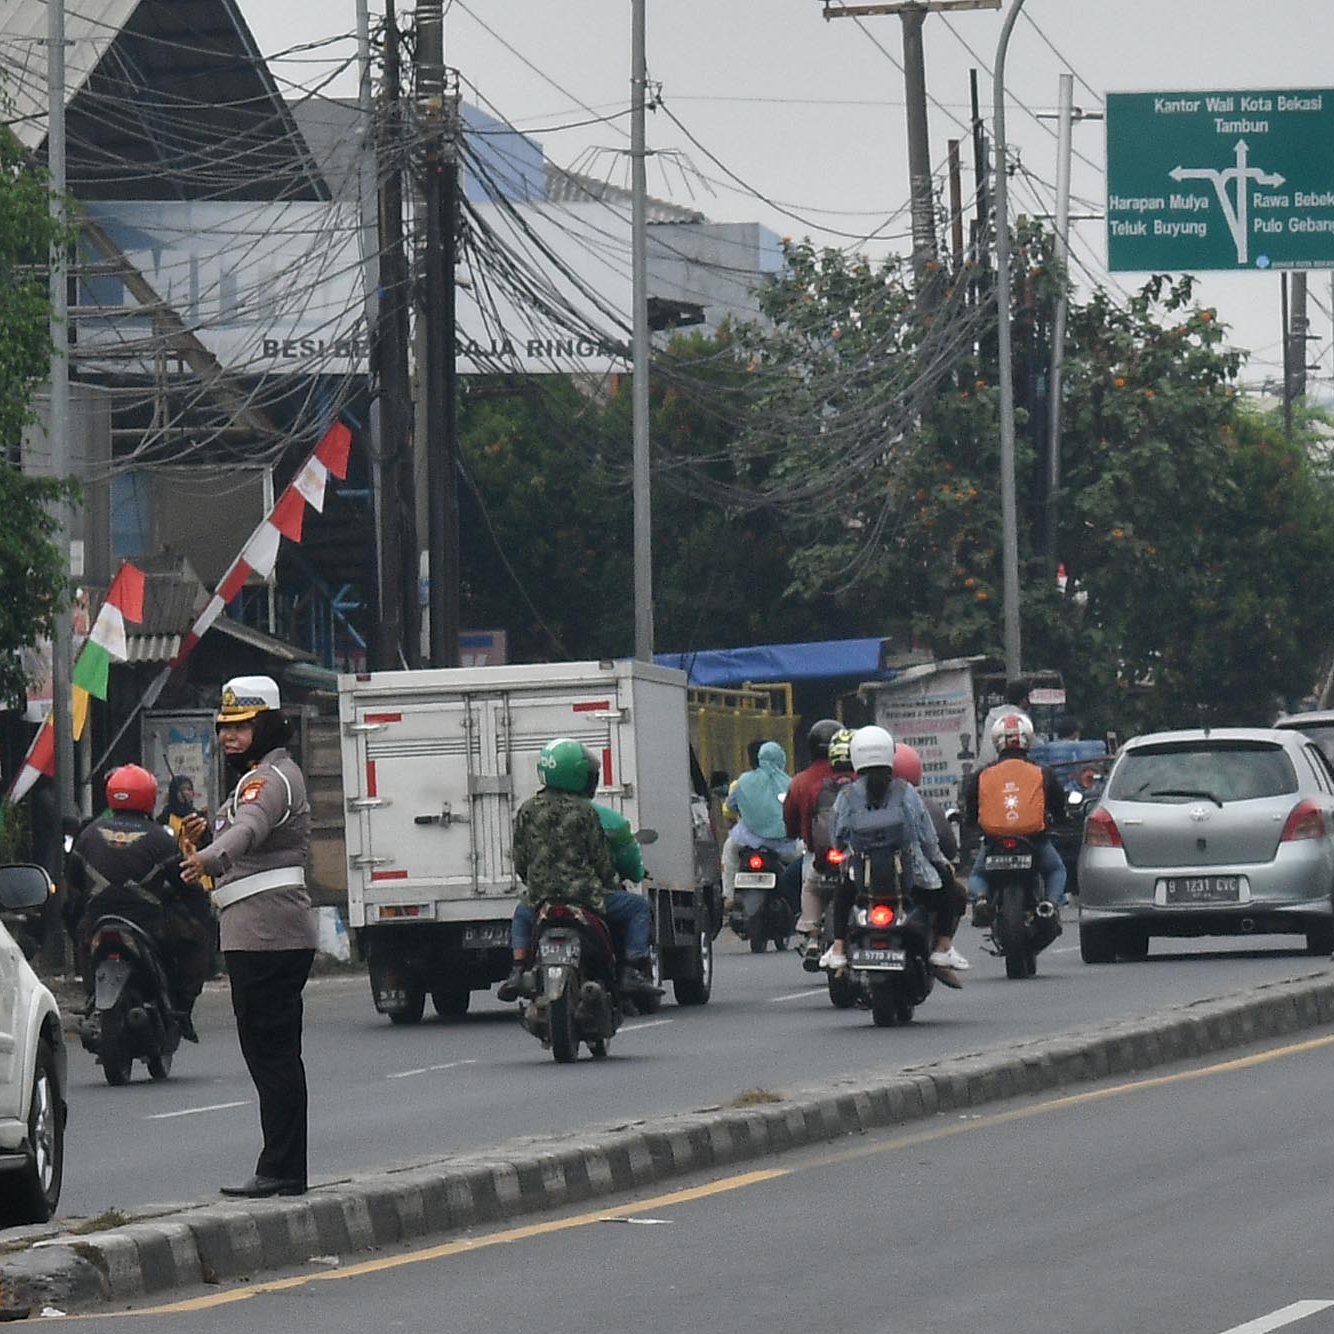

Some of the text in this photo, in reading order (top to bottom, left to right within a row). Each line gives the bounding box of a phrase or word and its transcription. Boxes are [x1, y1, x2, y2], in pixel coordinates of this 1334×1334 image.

[1154, 95, 1323, 113] Kantor Wali Kota Bekasi
[1214, 118, 1269, 134] Tambun
[1109, 194, 1210, 214] Harapan Mulya
[1253, 192, 1290, 208] Rawa
[1110, 219, 1208, 238] Teluk Buyung
[1253, 217, 1283, 234] Pulo
[263, 338, 321, 358] BESI
[1168, 882, 1176, 894] B
[1185, 880, 1210, 893] 1231
